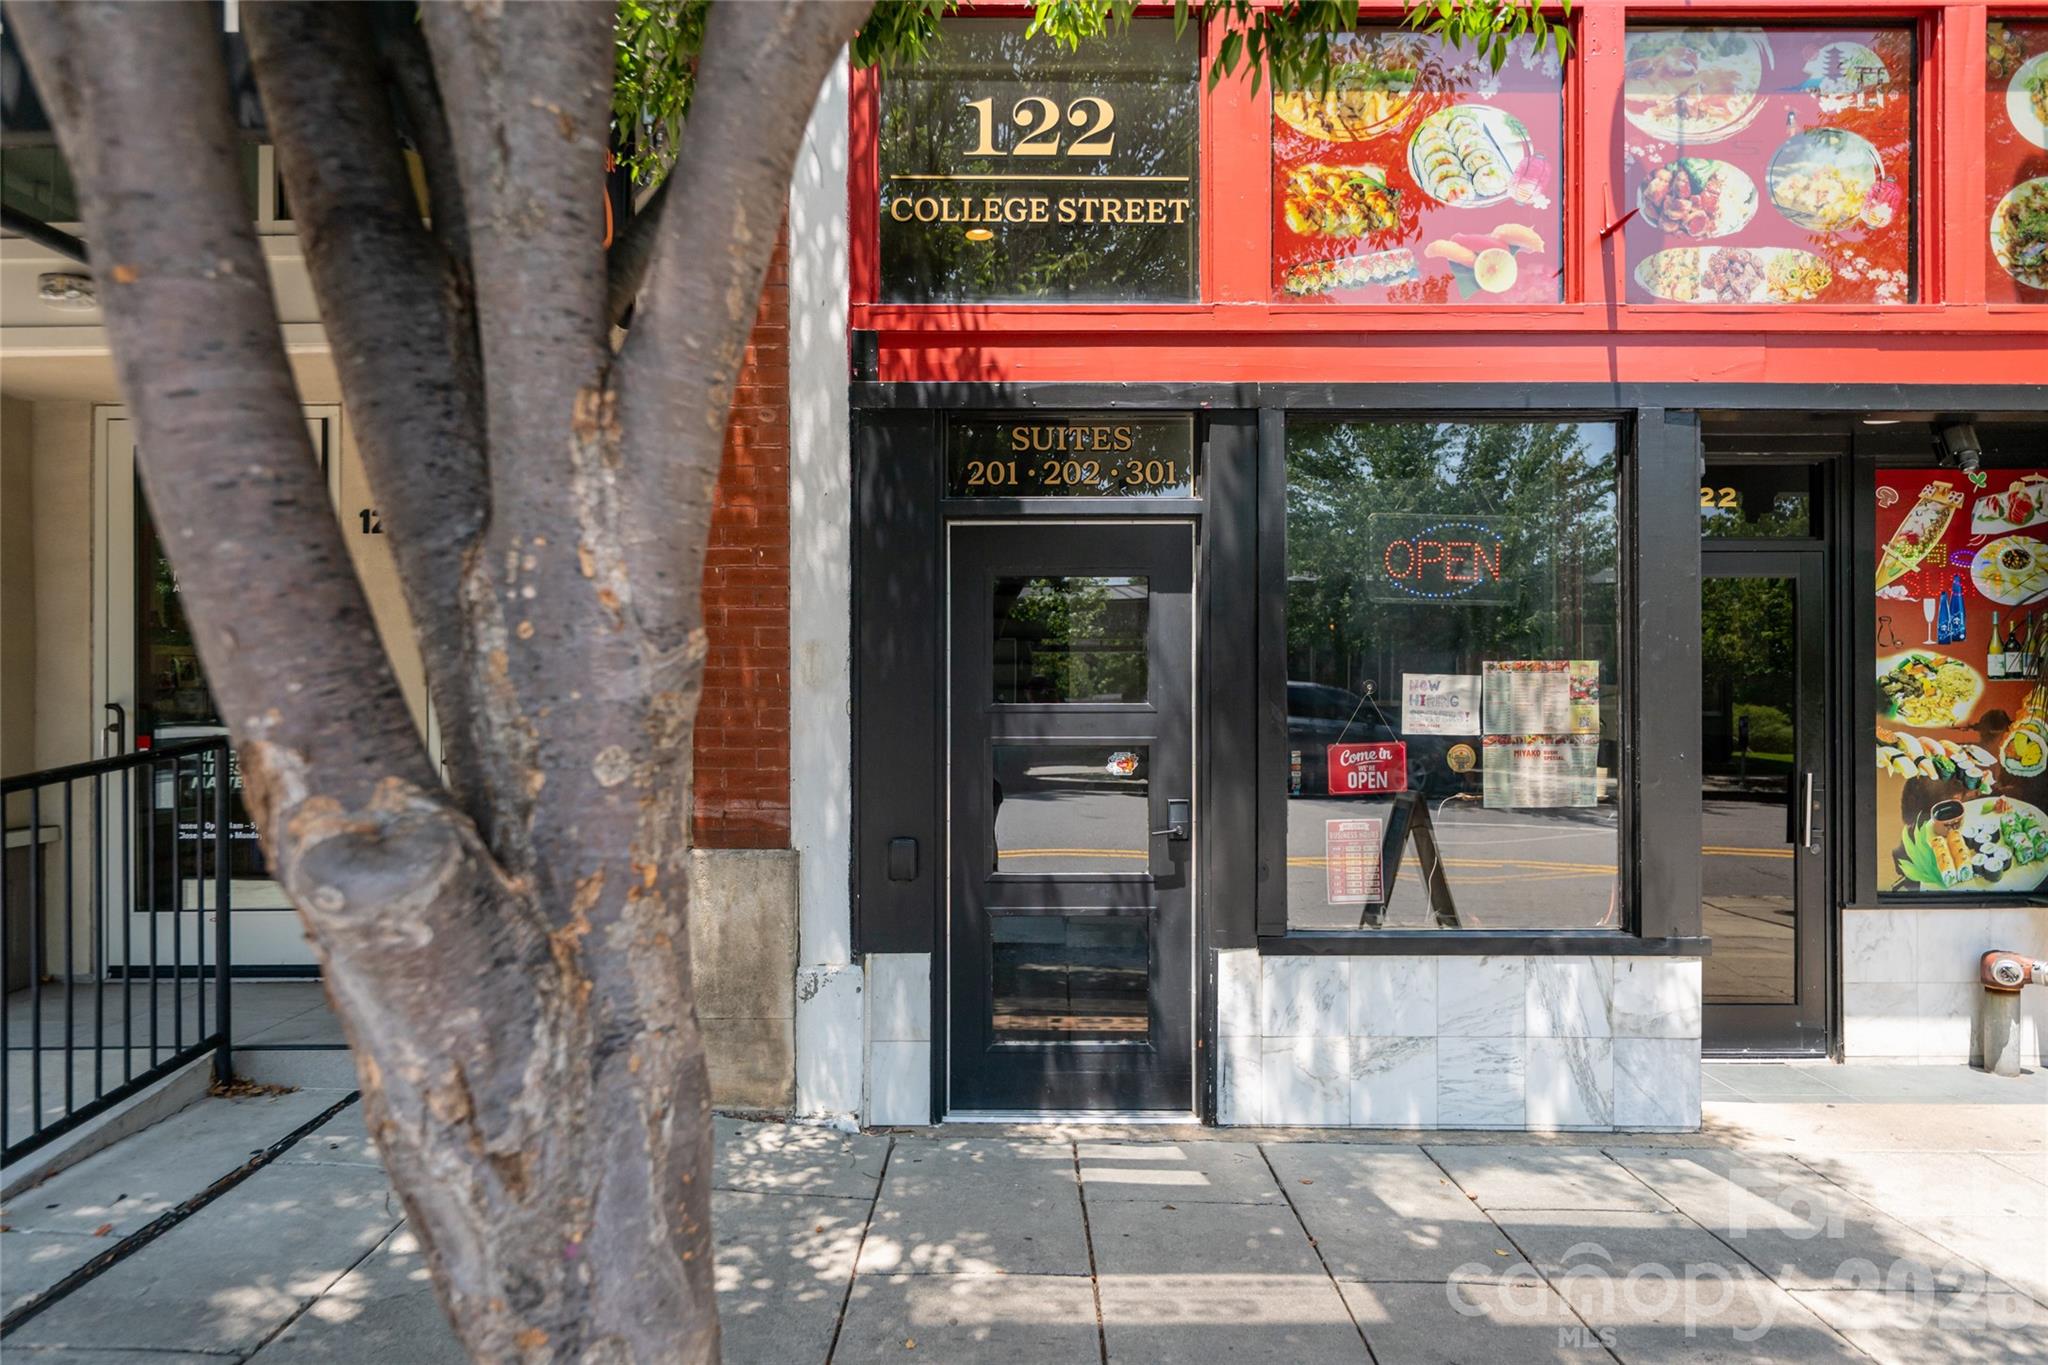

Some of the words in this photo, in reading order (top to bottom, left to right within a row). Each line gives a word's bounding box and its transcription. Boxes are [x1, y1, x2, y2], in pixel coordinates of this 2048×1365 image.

[963, 97, 1115, 156] 122
[890, 197, 1050, 224] COLLEGE
[1057, 198, 1190, 224] STREET
[1011, 426, 1133, 451] SUITES
[967, 461, 1018, 485] 201
[1043, 461, 1100, 485] 202
[1125, 460, 1177, 485] 301
[1700, 487, 1737, 507] 22
[1384, 539, 1501, 581] OPEN
[1409, 680, 1441, 692] NOW
[1340, 749, 1378, 767] Come
[1378, 747, 1393, 760] in
[1513, 749, 1541, 759] MIYAKO
[1347, 770, 1389, 789] OPEN
